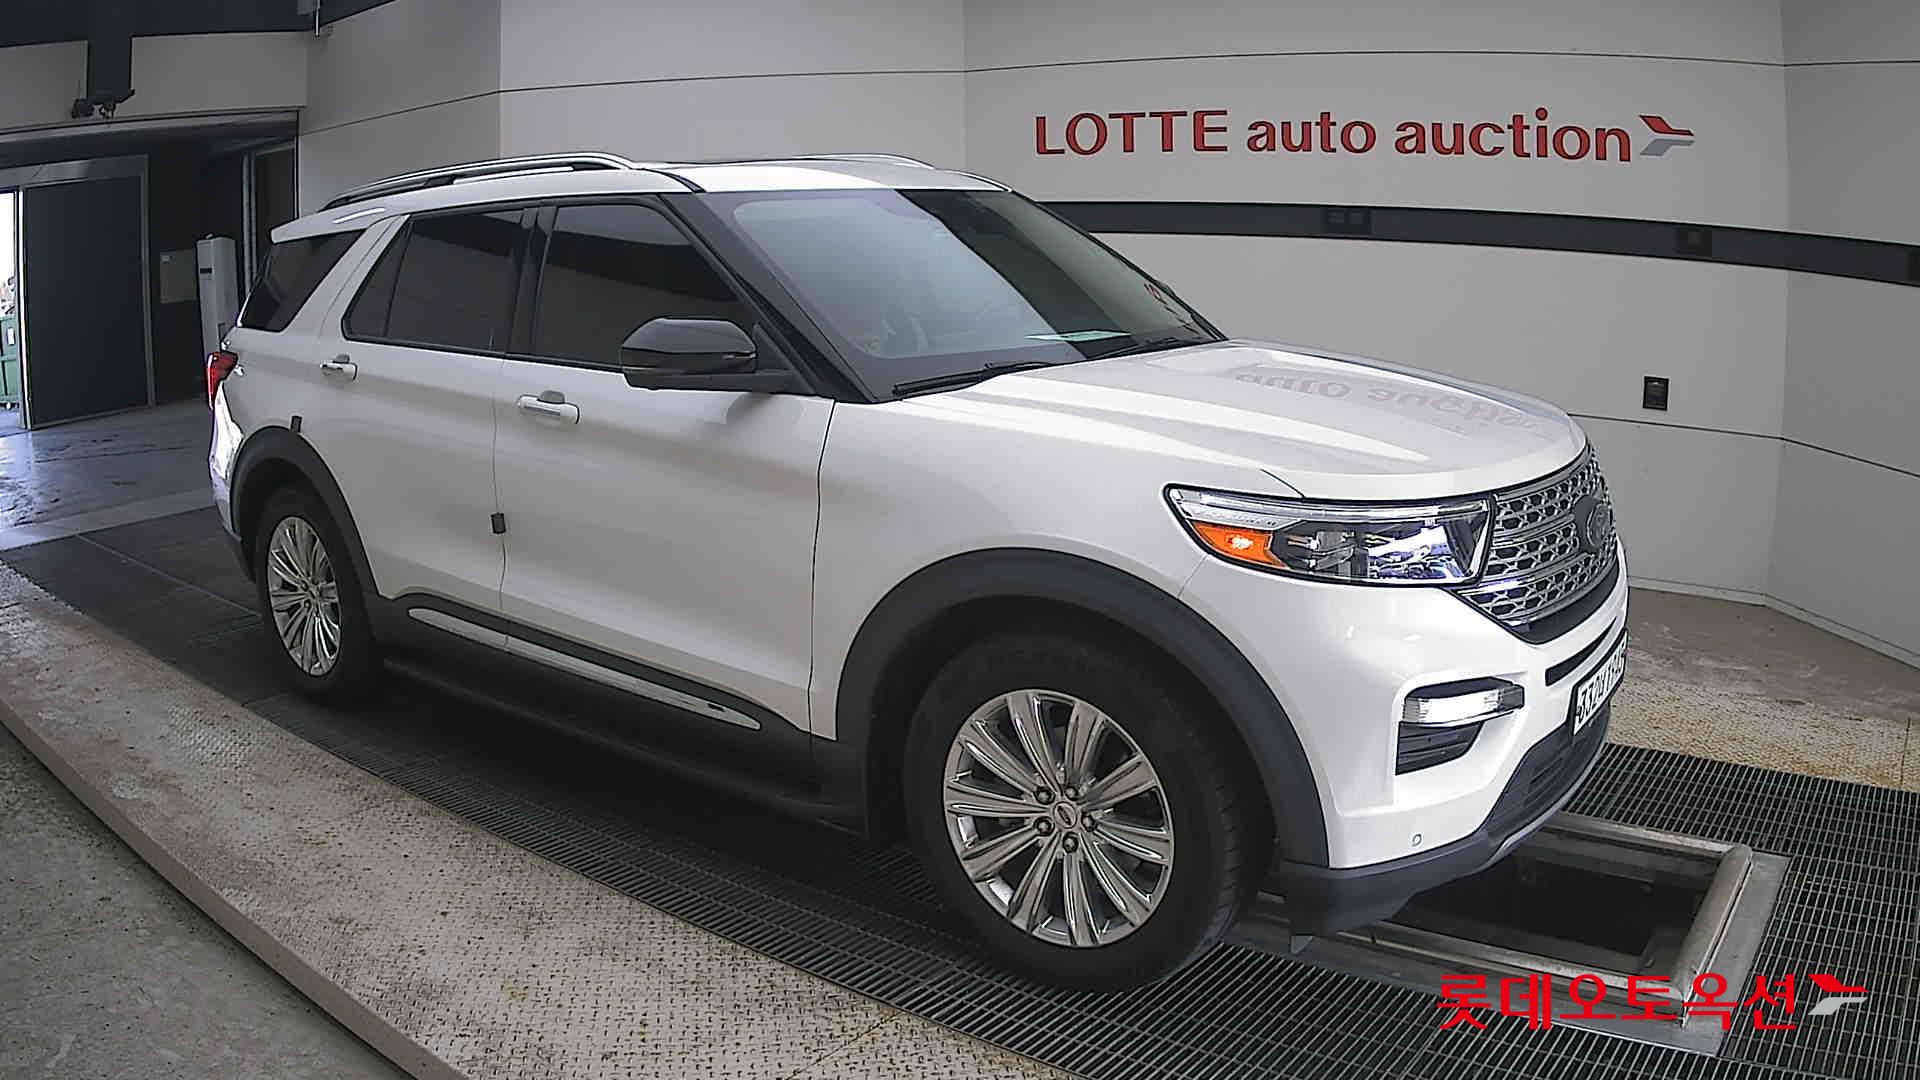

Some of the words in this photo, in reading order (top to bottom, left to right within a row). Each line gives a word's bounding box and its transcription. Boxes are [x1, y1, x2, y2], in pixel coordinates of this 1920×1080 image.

[1035, 109, 1228, 156] LOTTE
[1246, 111, 1377, 154] auto
[1394, 107, 1631, 162] auction
